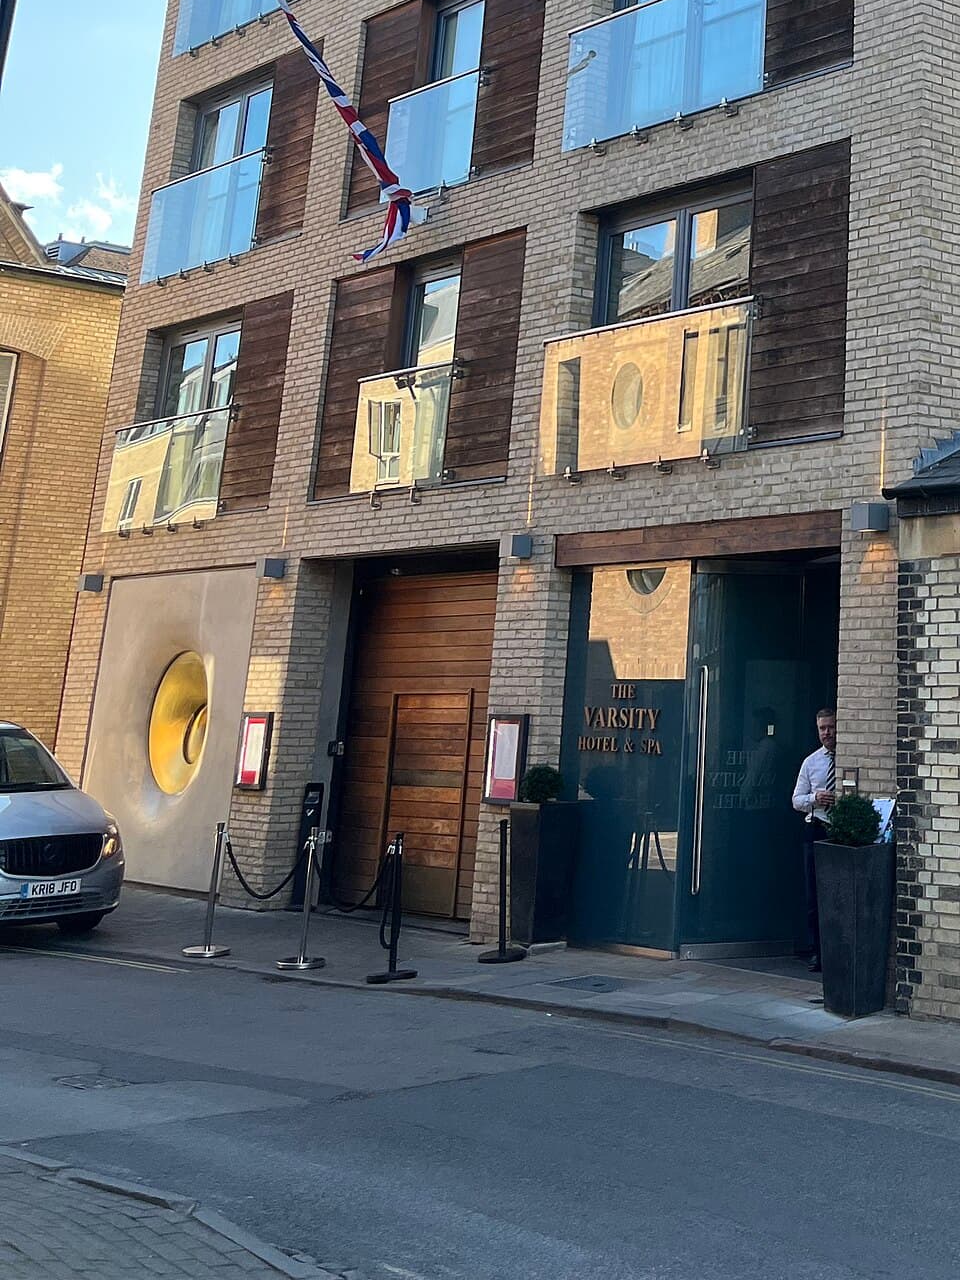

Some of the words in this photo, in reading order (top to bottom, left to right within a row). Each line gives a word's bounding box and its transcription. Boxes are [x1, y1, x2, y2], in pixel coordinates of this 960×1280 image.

[611, 683, 636, 699] THE
[584, 706, 661, 730] VARSITY
[578, 735, 618, 752] HOTEL
[623, 737, 635, 753] &
[641, 738, 662, 755] SPA
[31, 882, 55, 896] KR18
[57, 880, 77, 893] JFO
